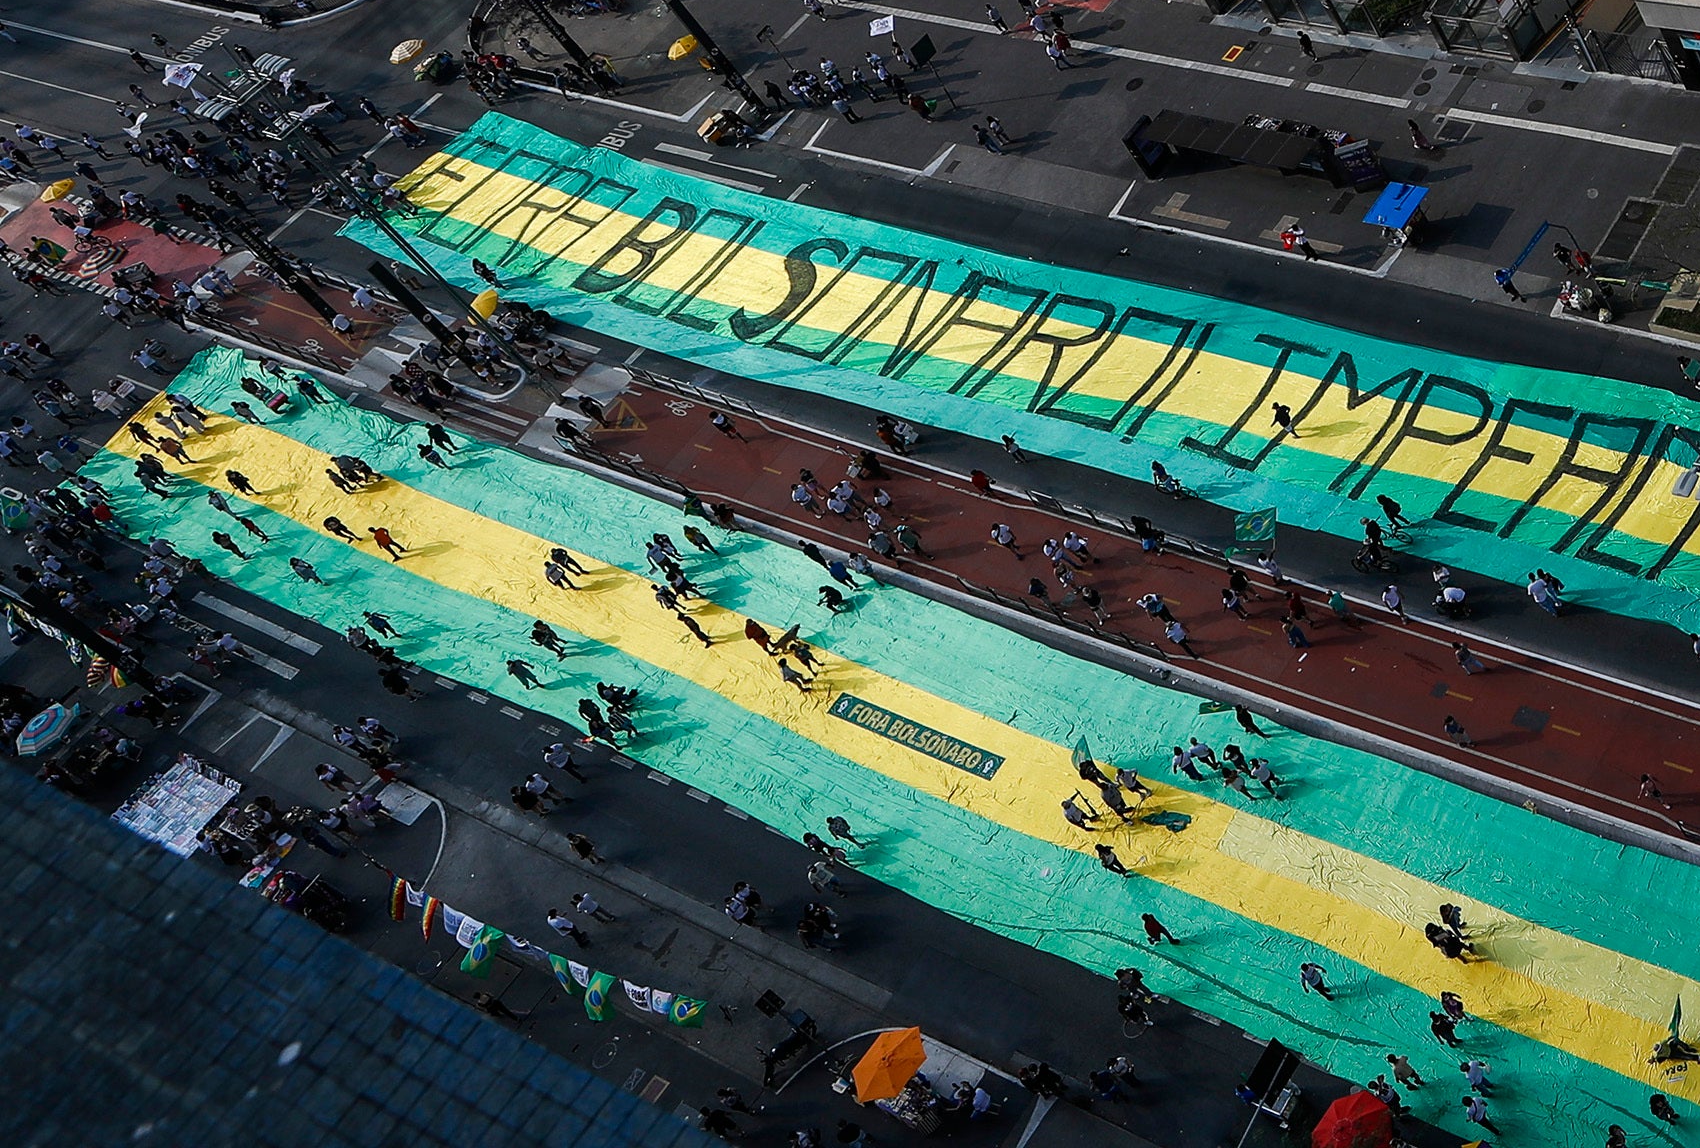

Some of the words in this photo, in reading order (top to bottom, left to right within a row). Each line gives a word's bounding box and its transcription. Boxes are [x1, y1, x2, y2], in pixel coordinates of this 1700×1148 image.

[400, 137, 640, 280] FORA
[847, 703, 892, 733] FORA
[885, 719, 983, 770] BOLSONARO
